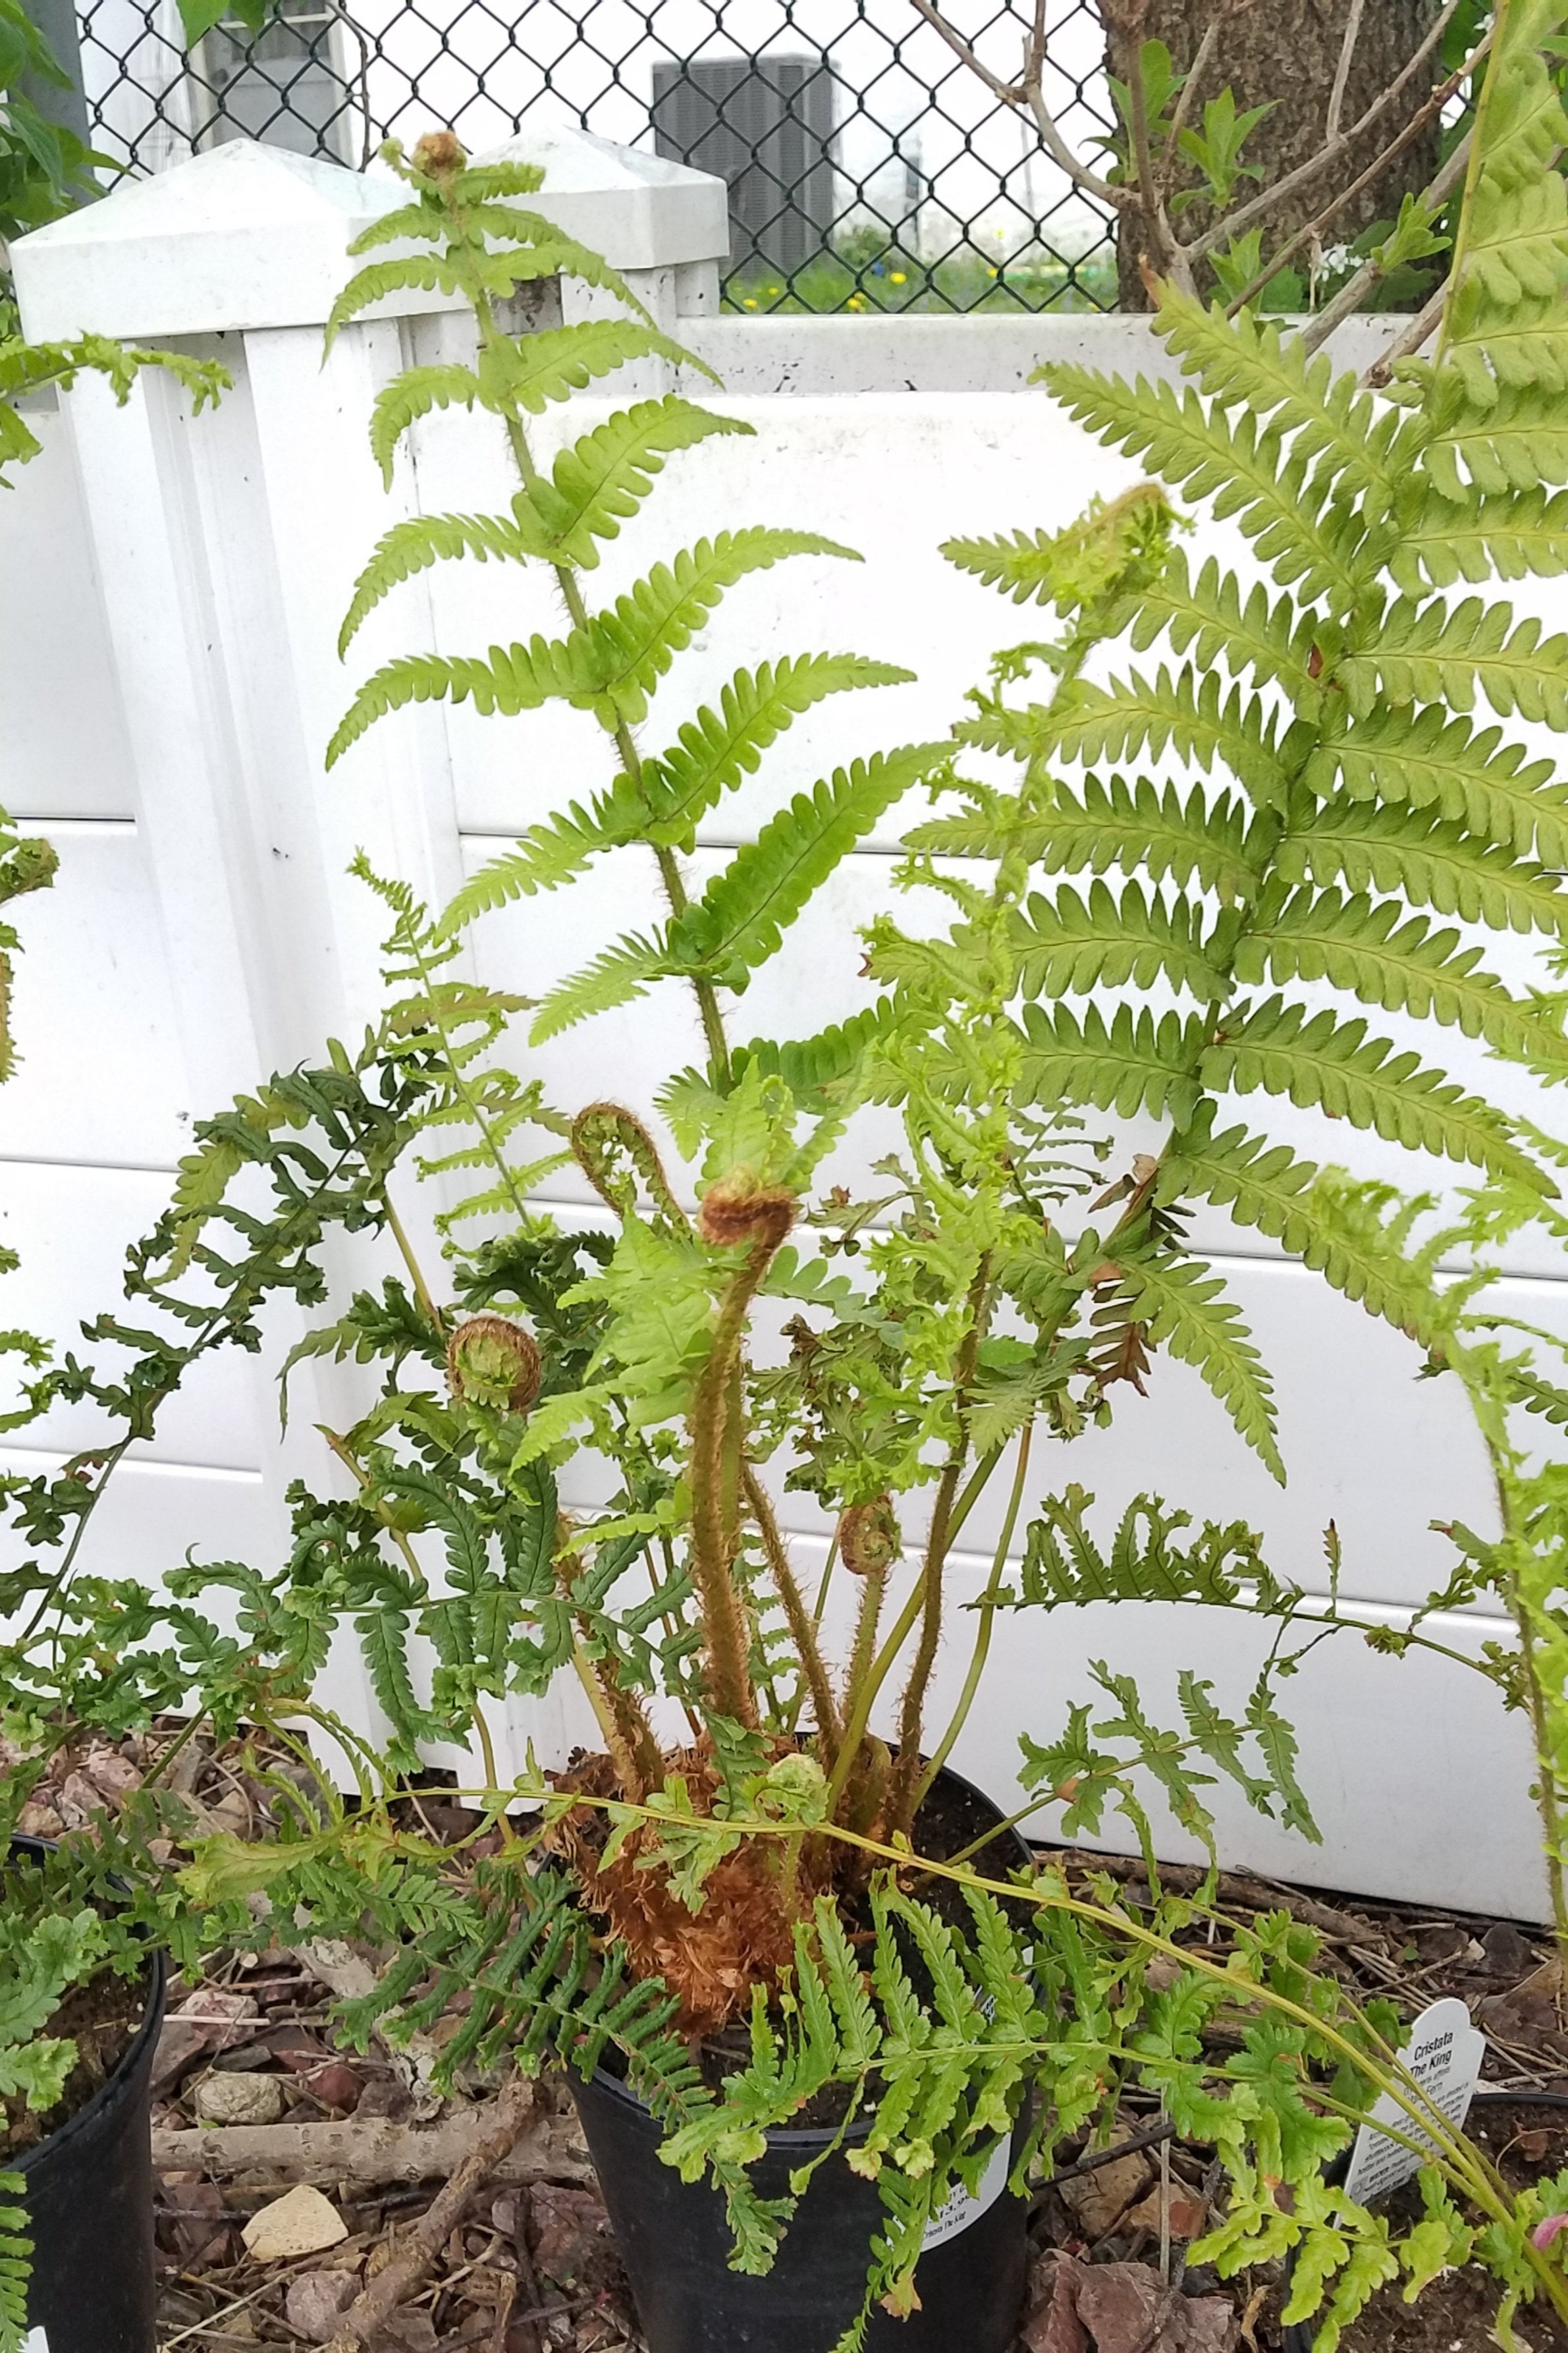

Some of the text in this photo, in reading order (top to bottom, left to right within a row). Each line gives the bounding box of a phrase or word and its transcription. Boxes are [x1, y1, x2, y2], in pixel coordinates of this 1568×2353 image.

[1414, 2032, 1453, 2061] Cristata
[1410, 2050, 1452, 2078] The King
